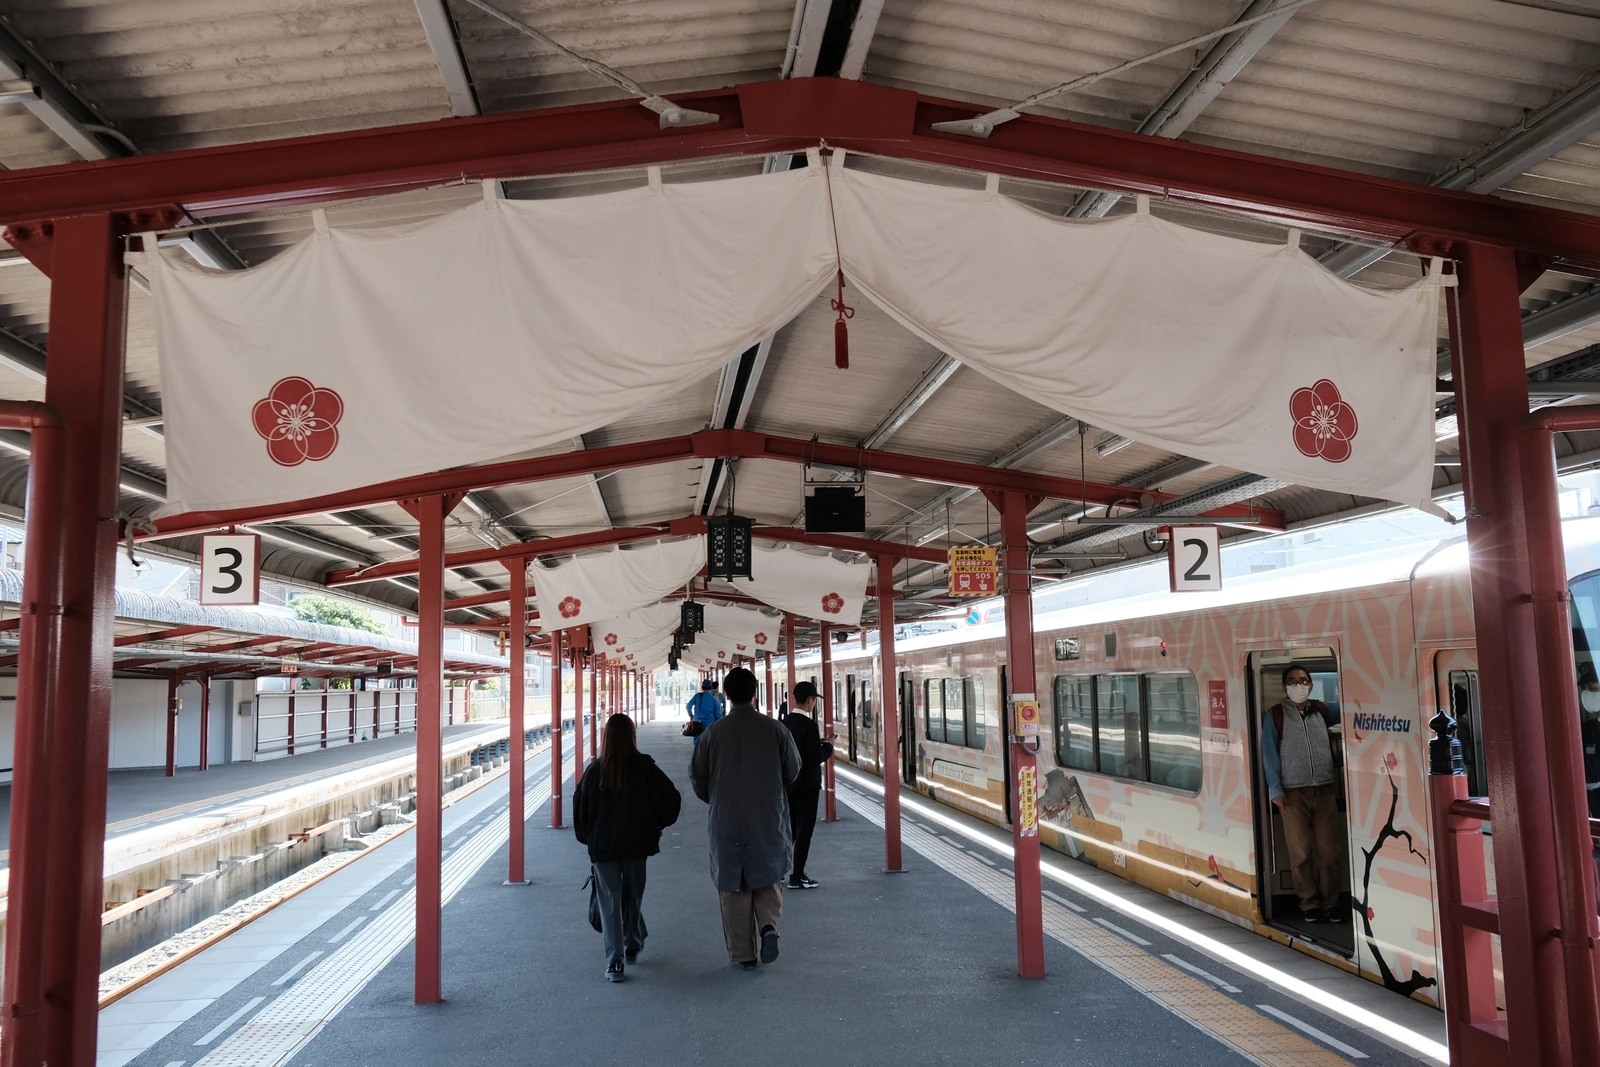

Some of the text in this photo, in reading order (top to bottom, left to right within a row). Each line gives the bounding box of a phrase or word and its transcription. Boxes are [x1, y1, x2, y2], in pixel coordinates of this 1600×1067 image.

[212, 547, 242, 594] 3
[1183, 538, 1211, 581] 2
[1353, 712, 1411, 733] Nishitetsu
